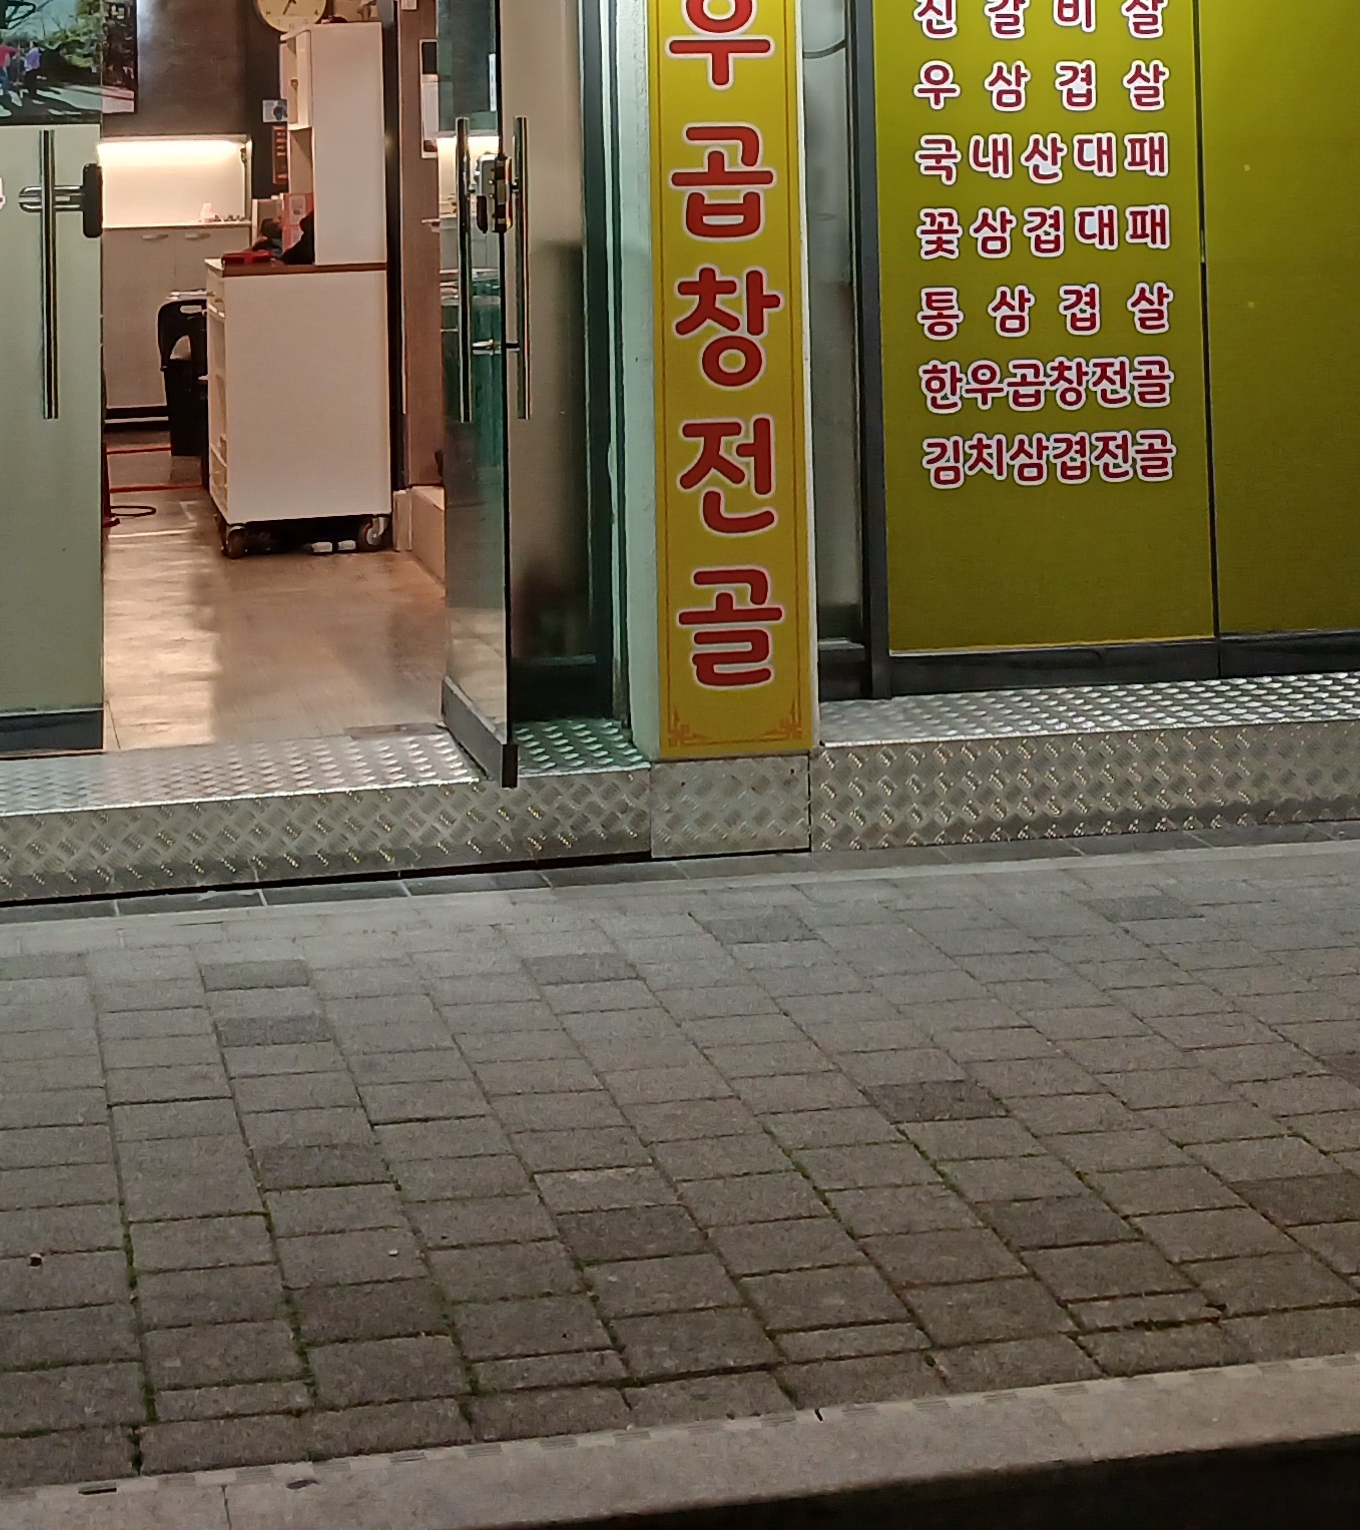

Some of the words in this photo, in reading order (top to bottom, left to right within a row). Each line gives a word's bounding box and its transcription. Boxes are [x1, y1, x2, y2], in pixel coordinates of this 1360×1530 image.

[916, 133, 1168, 184] 국내산대패
[918, 205, 1170, 259] 꽃삼겹대패
[921, 357, 1173, 413] 한우곱창전골
[924, 431, 1176, 488] 김치삼겹전골
